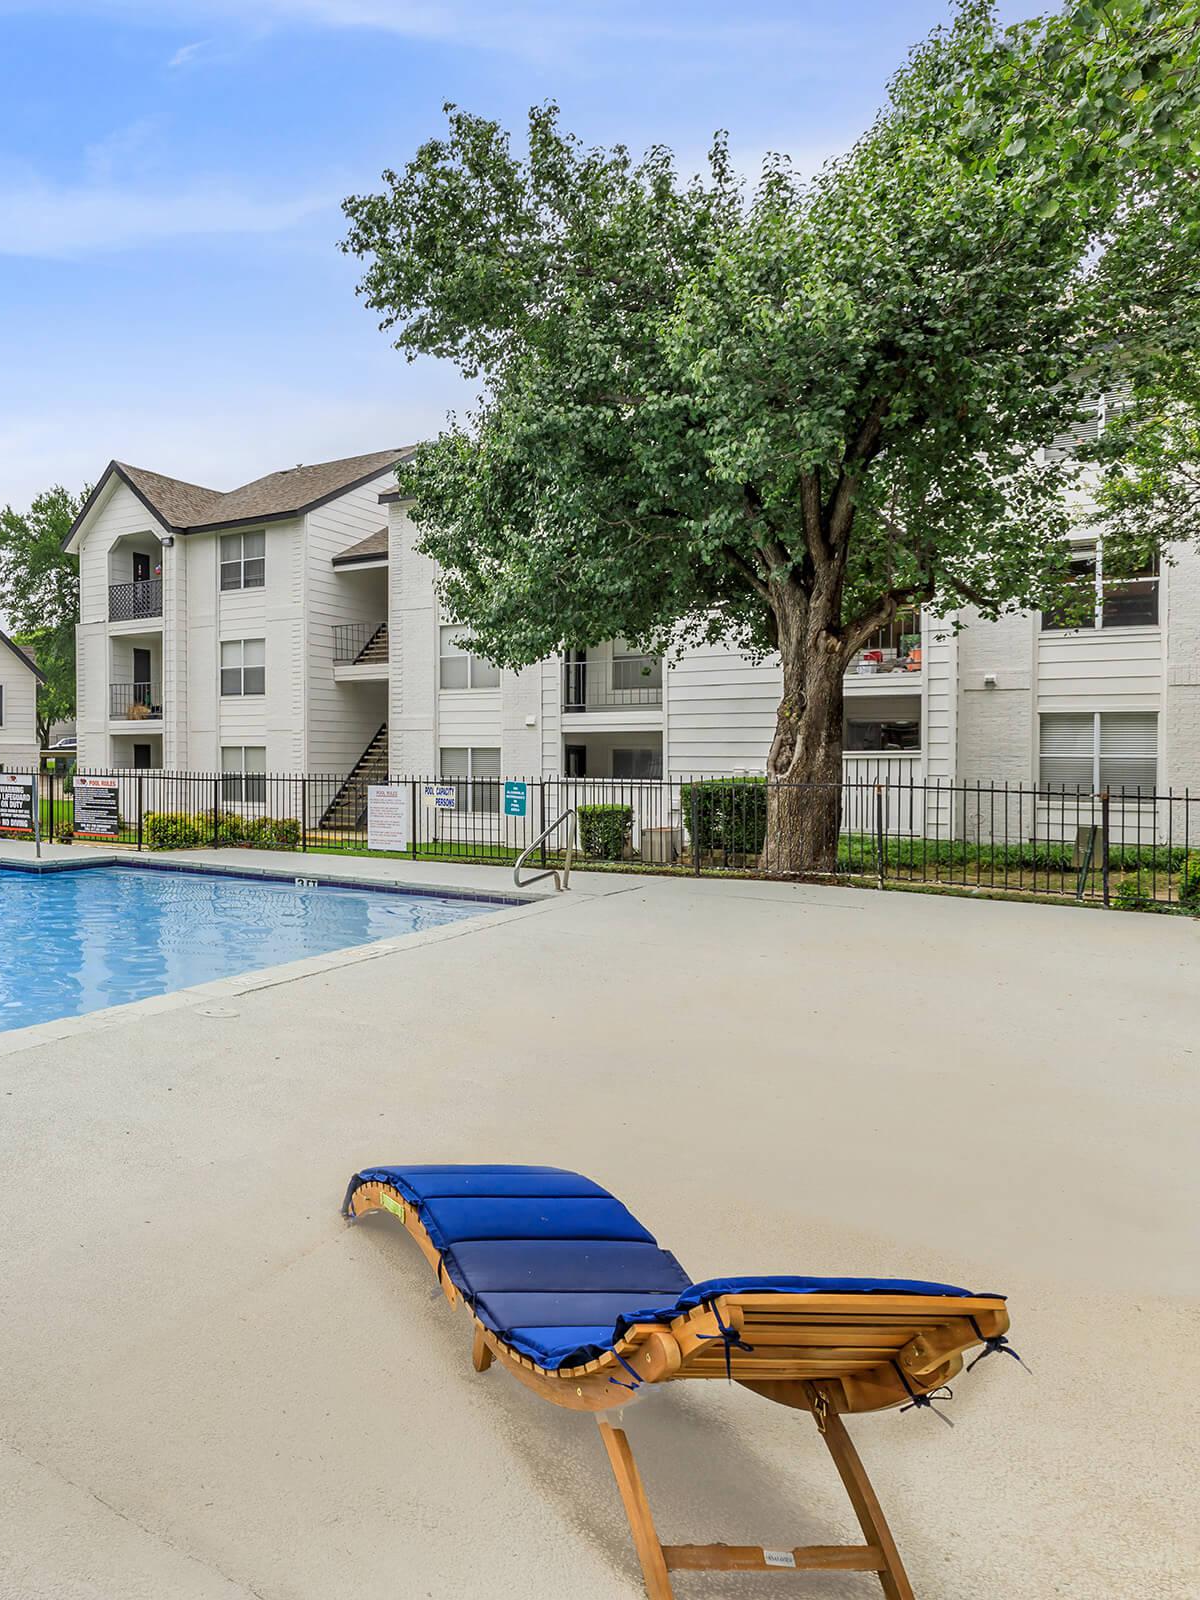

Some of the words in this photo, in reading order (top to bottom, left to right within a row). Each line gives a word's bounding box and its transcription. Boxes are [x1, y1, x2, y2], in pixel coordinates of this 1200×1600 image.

[424, 786, 434, 795] POOL
[435, 787, 455, 796] CAPACITY
[9, 801, 23, 809] DUTY
[435, 797, 455, 807] PERSONS
